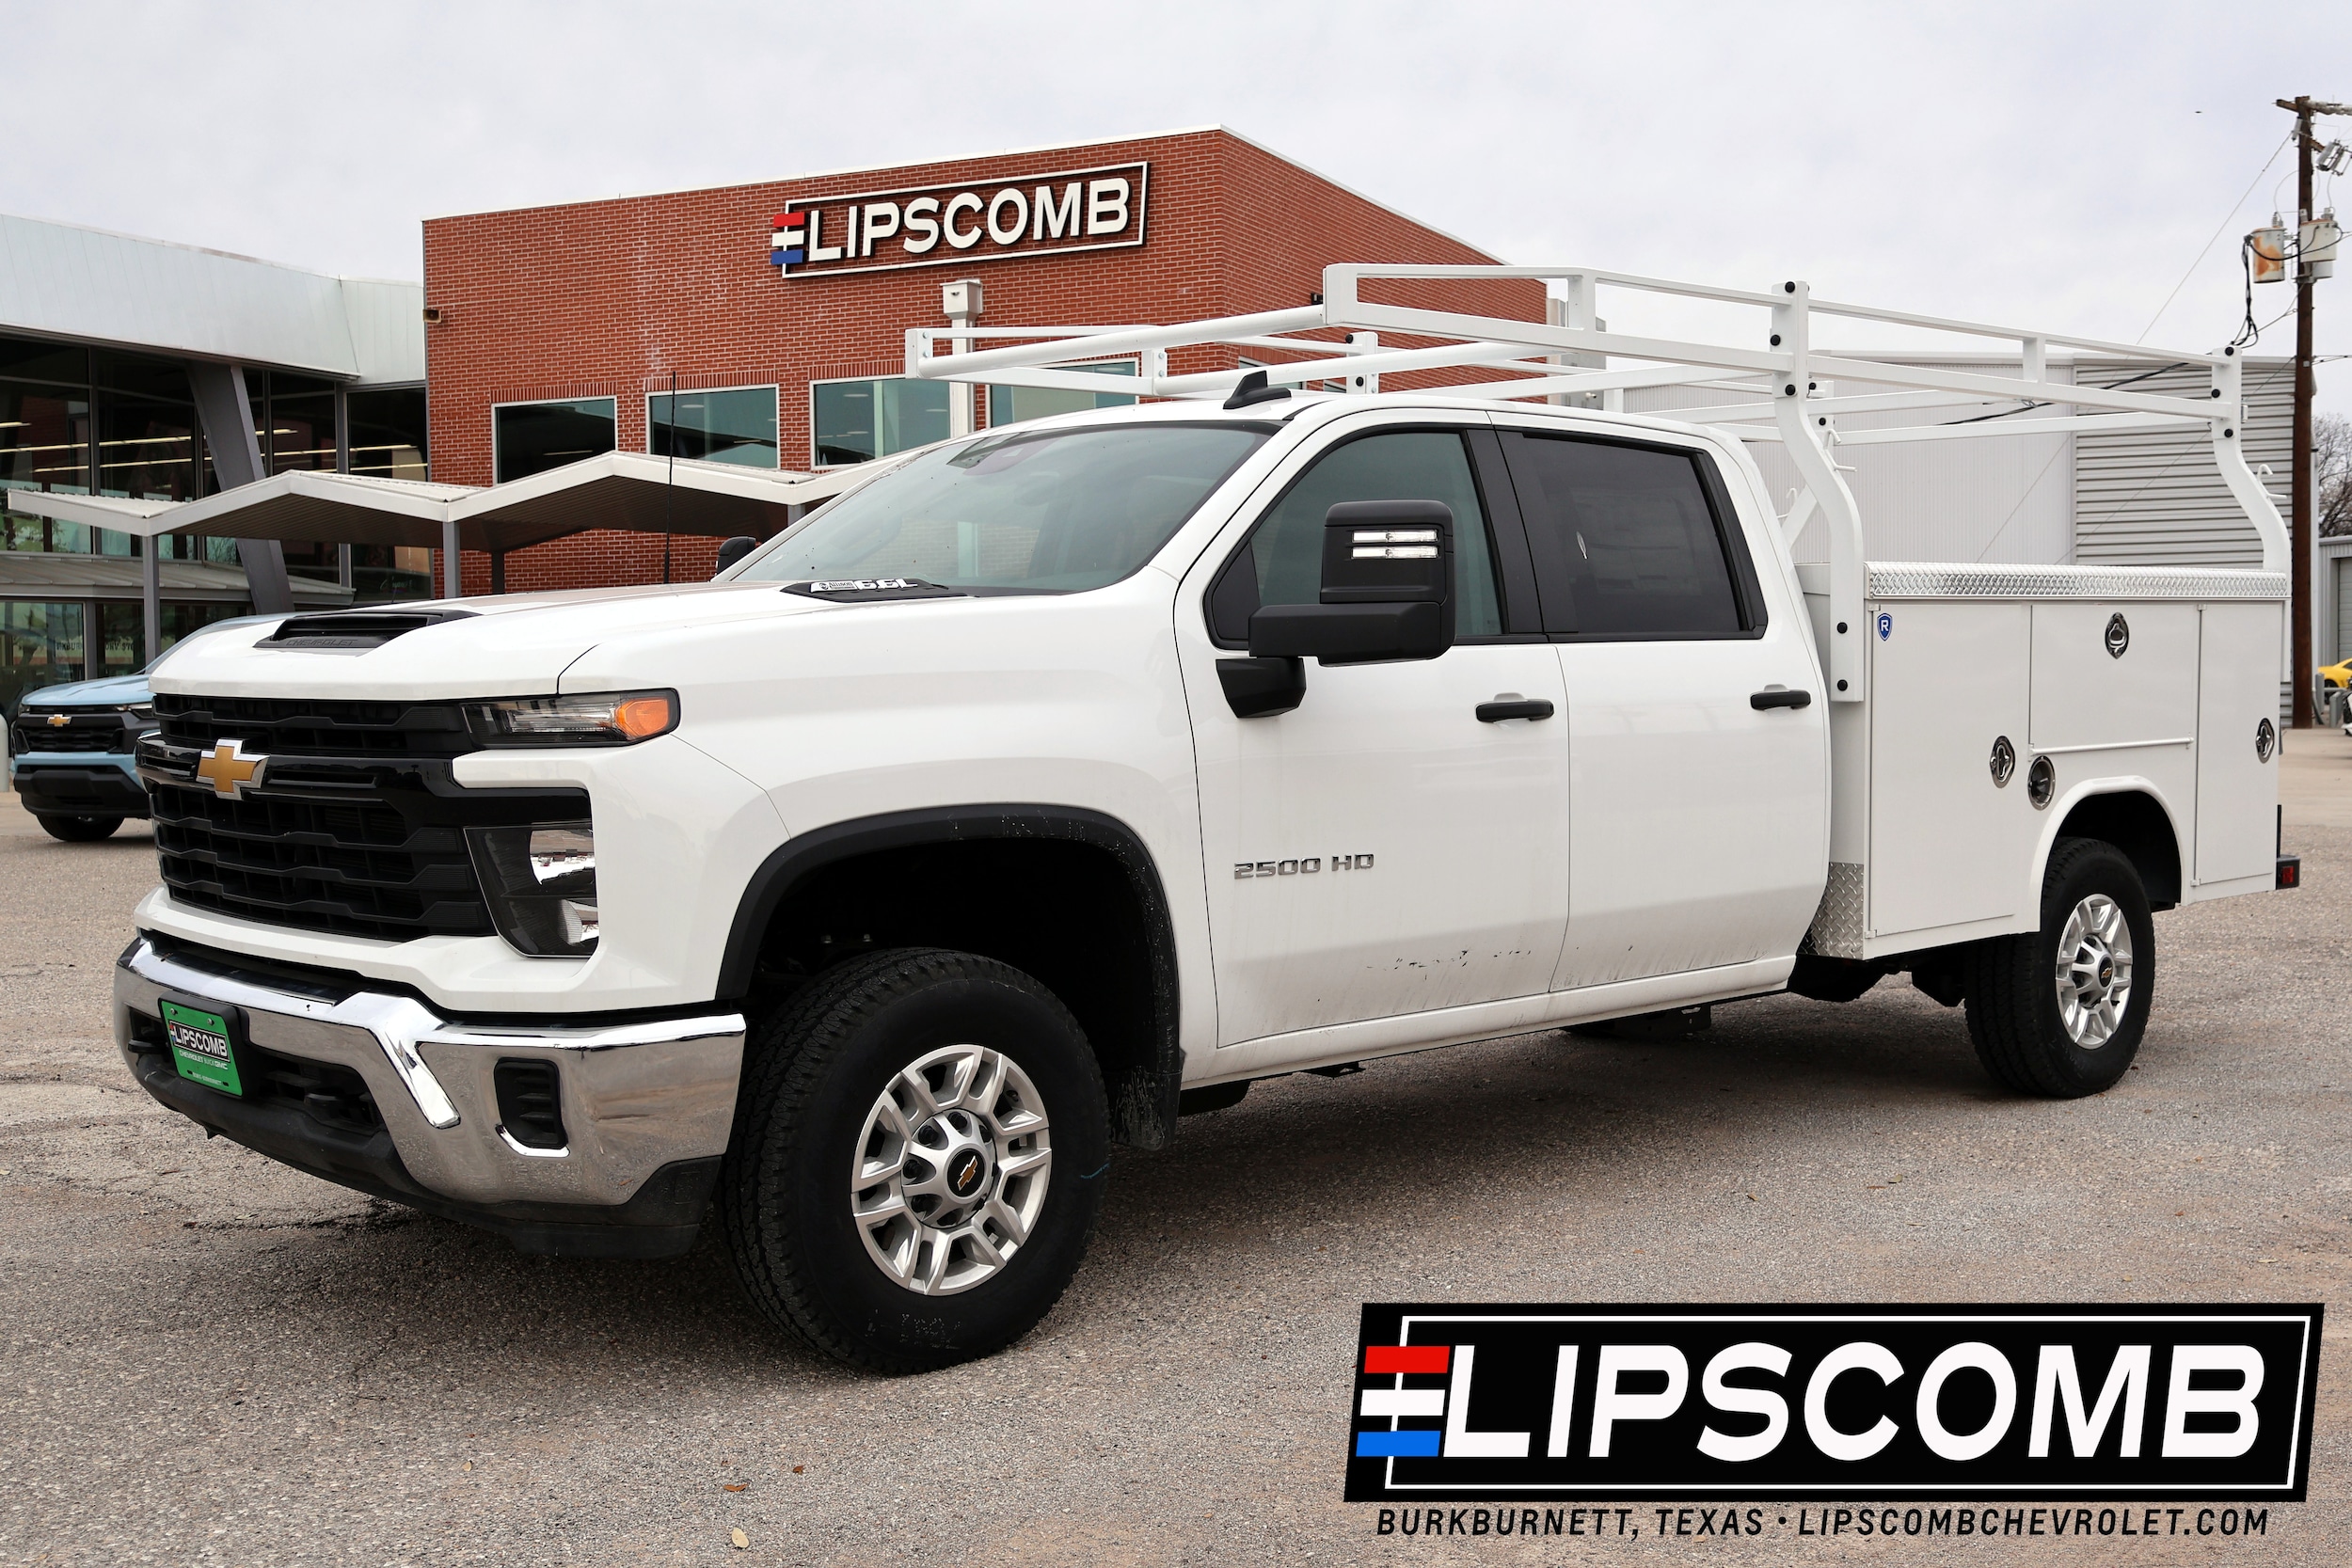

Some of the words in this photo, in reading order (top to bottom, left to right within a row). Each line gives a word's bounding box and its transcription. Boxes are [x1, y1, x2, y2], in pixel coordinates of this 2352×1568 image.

[808, 177, 1130, 262] LIPSCOMB
[1233, 857, 1321, 880] 2500
[1331, 853, 1375, 872] HD
[174, 1025, 228, 1056] LIPSCOMB
[179, 1050, 204, 1063] CHEVROLET
